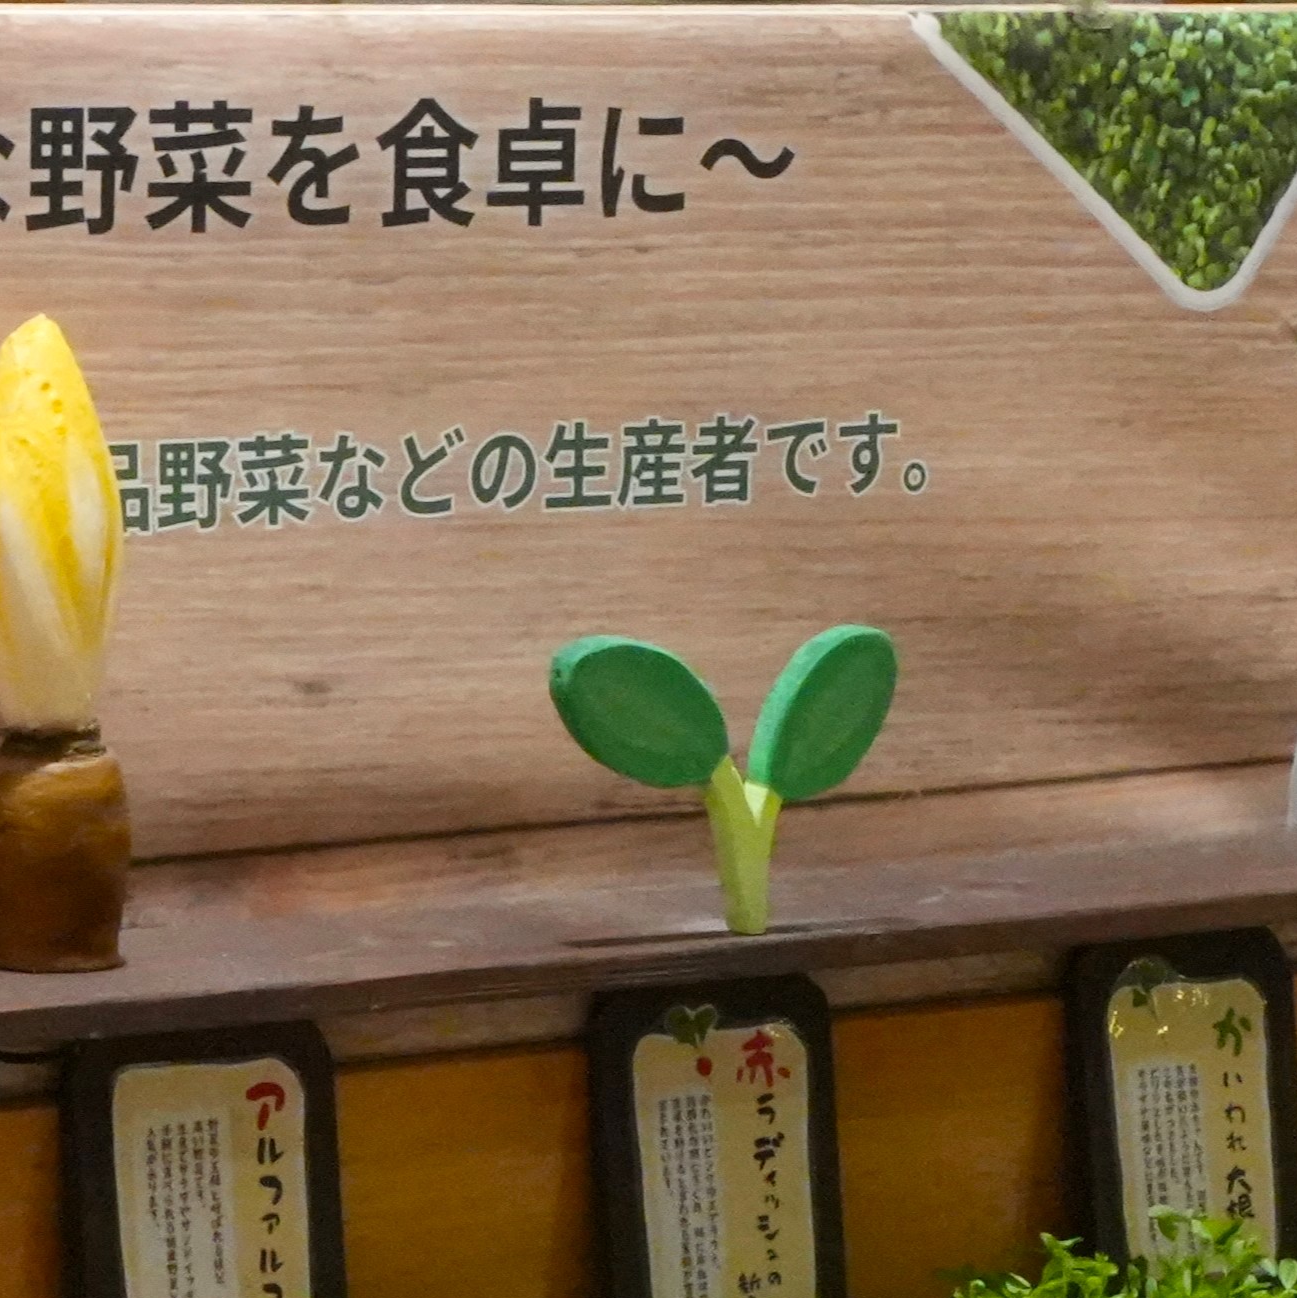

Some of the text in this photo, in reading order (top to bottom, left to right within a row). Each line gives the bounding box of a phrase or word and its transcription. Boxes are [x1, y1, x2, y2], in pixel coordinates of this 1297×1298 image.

[1212, 1007, 1255, 1219] かいわれ大根
